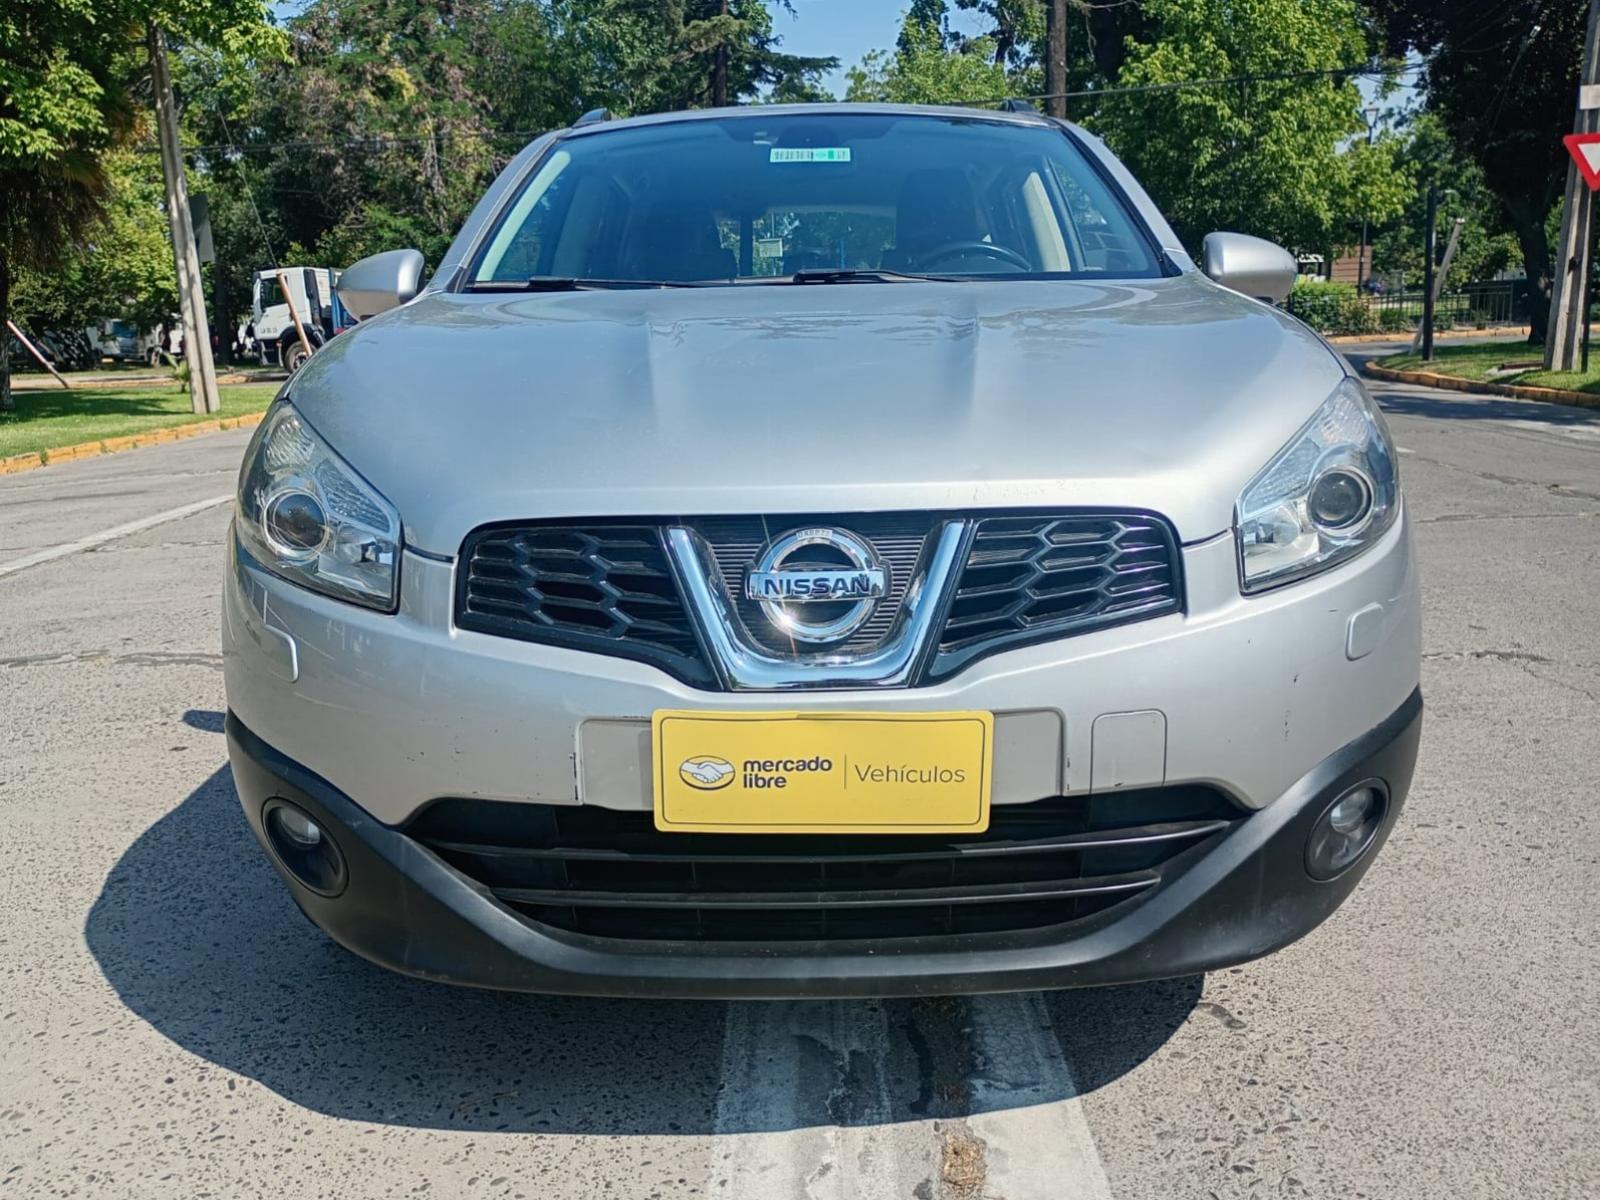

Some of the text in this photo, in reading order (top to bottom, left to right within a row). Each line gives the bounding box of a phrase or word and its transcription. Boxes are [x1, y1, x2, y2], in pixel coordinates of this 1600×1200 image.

[764, 576, 870, 595] NISSAN
[743, 756, 832, 772] mercado
[743, 773, 787, 788] libre
[854, 764, 966, 783] Vehículos
